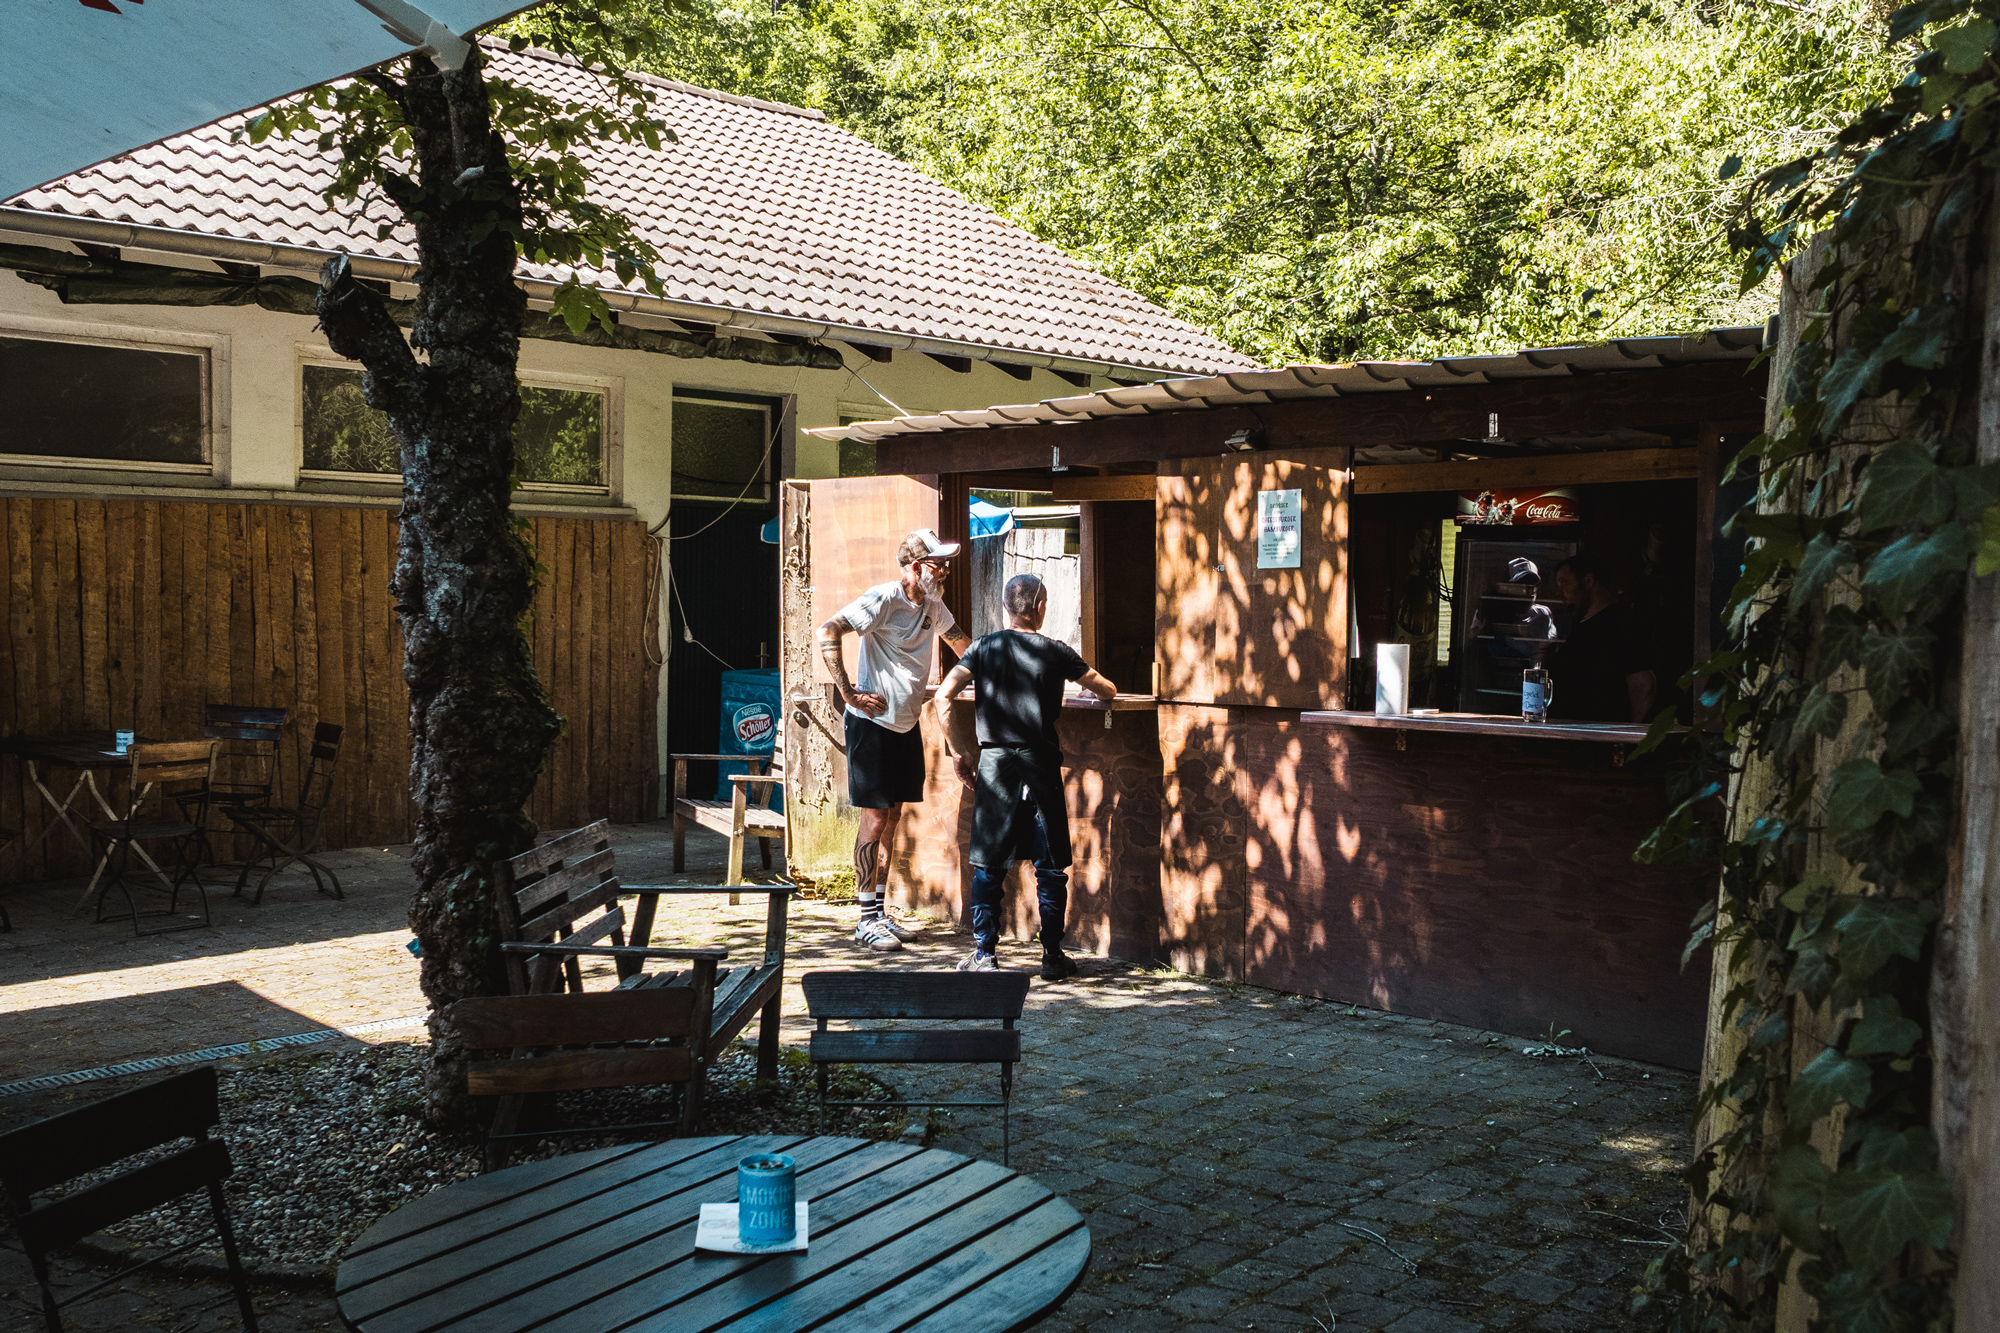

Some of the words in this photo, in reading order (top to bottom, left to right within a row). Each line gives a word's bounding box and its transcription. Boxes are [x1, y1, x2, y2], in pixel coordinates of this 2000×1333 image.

[1526, 503, 1562, 519] Coca-Cola
[740, 717, 771, 740] Schöller
[749, 1207, 789, 1229] ZONE
